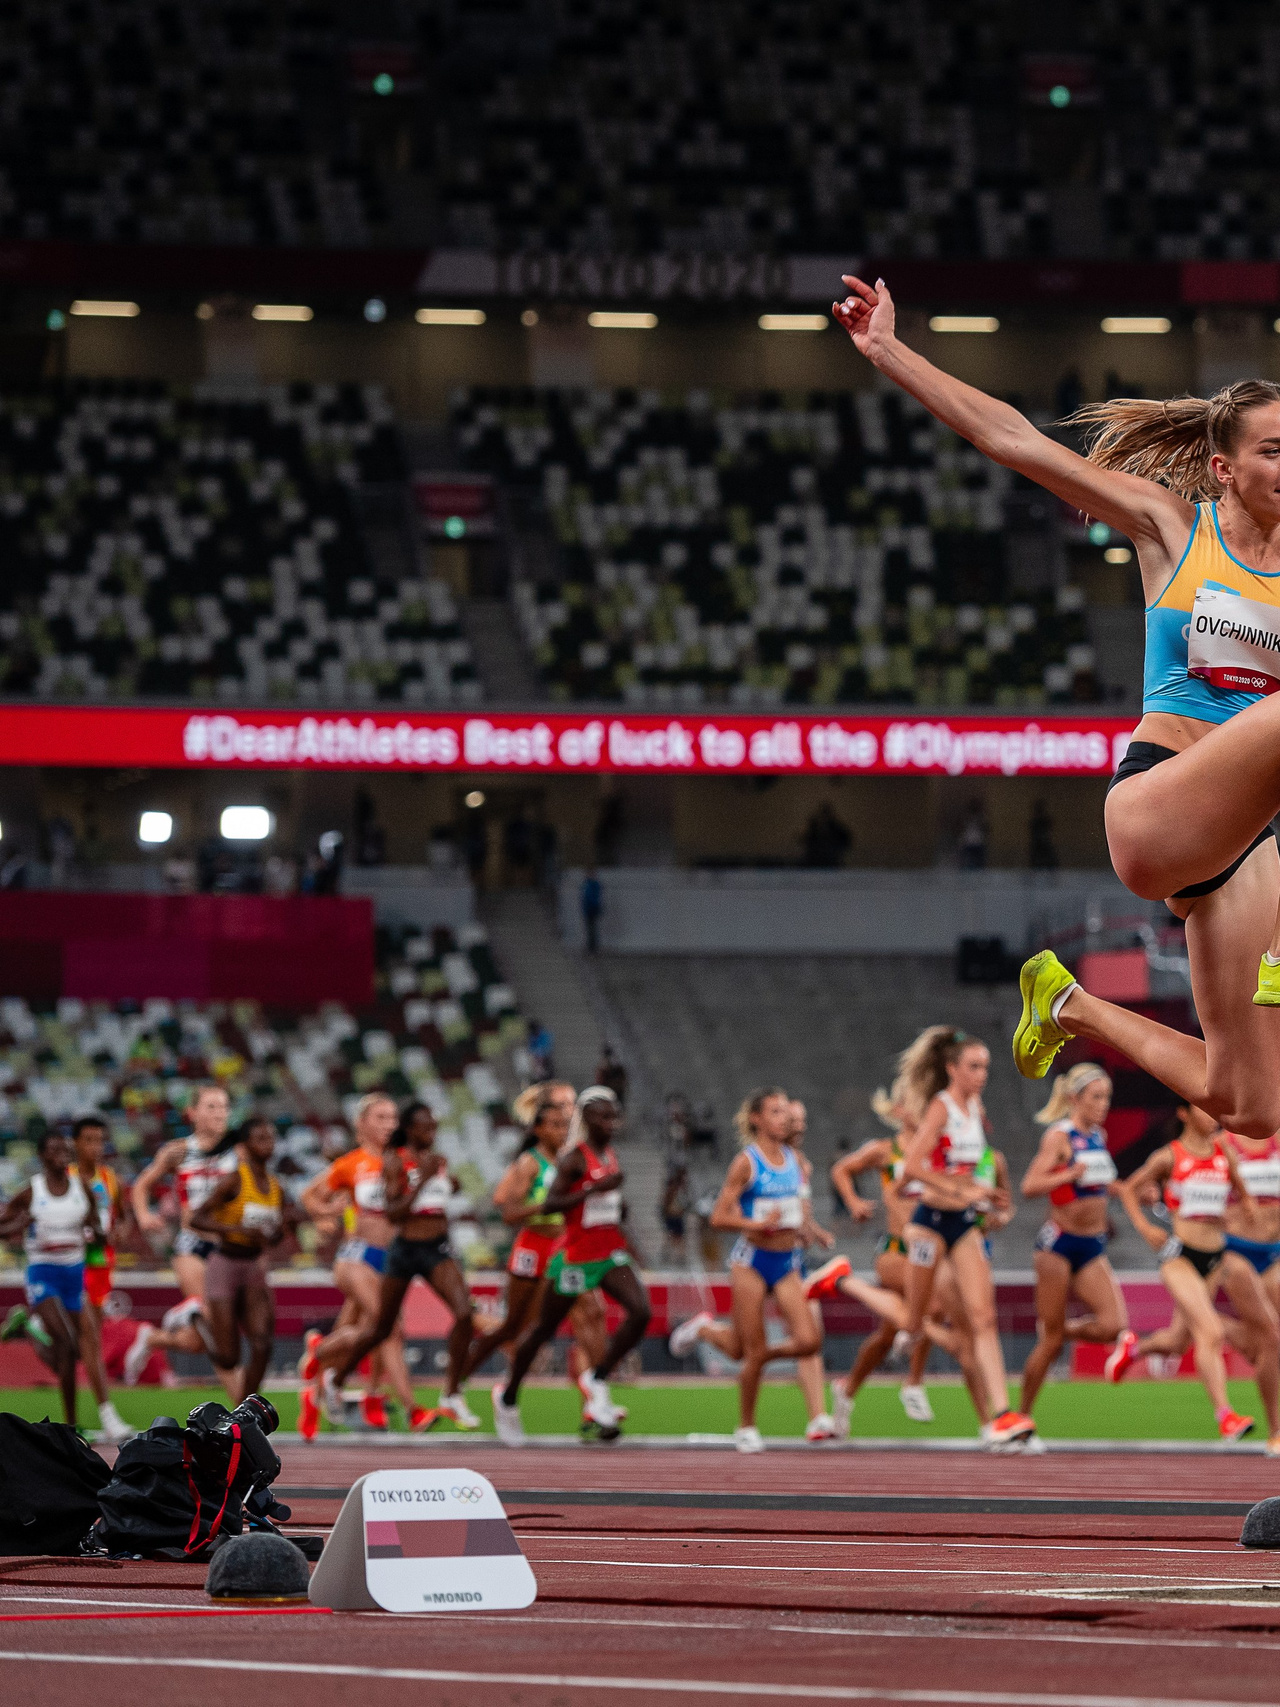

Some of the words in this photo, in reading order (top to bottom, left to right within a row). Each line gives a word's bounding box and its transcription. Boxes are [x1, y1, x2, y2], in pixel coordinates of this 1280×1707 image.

[1223, 673, 1239, 683] TOKYO
[1238, 676, 1251, 685] 2020
[183, 716, 459, 763] #DearAthletes
[464, 719, 552, 764] Best
[558, 721, 604, 766] of
[608, 721, 694, 766] luck
[699, 724, 746, 767] to
[749, 722, 803, 767] all
[809, 722, 878, 767] the
[883, 722, 1108, 775] #Olympians
[370, 1490, 412, 1503] TOKYO
[414, 1489, 446, 1502] 2020
[432, 1592, 482, 1603] MONDO
